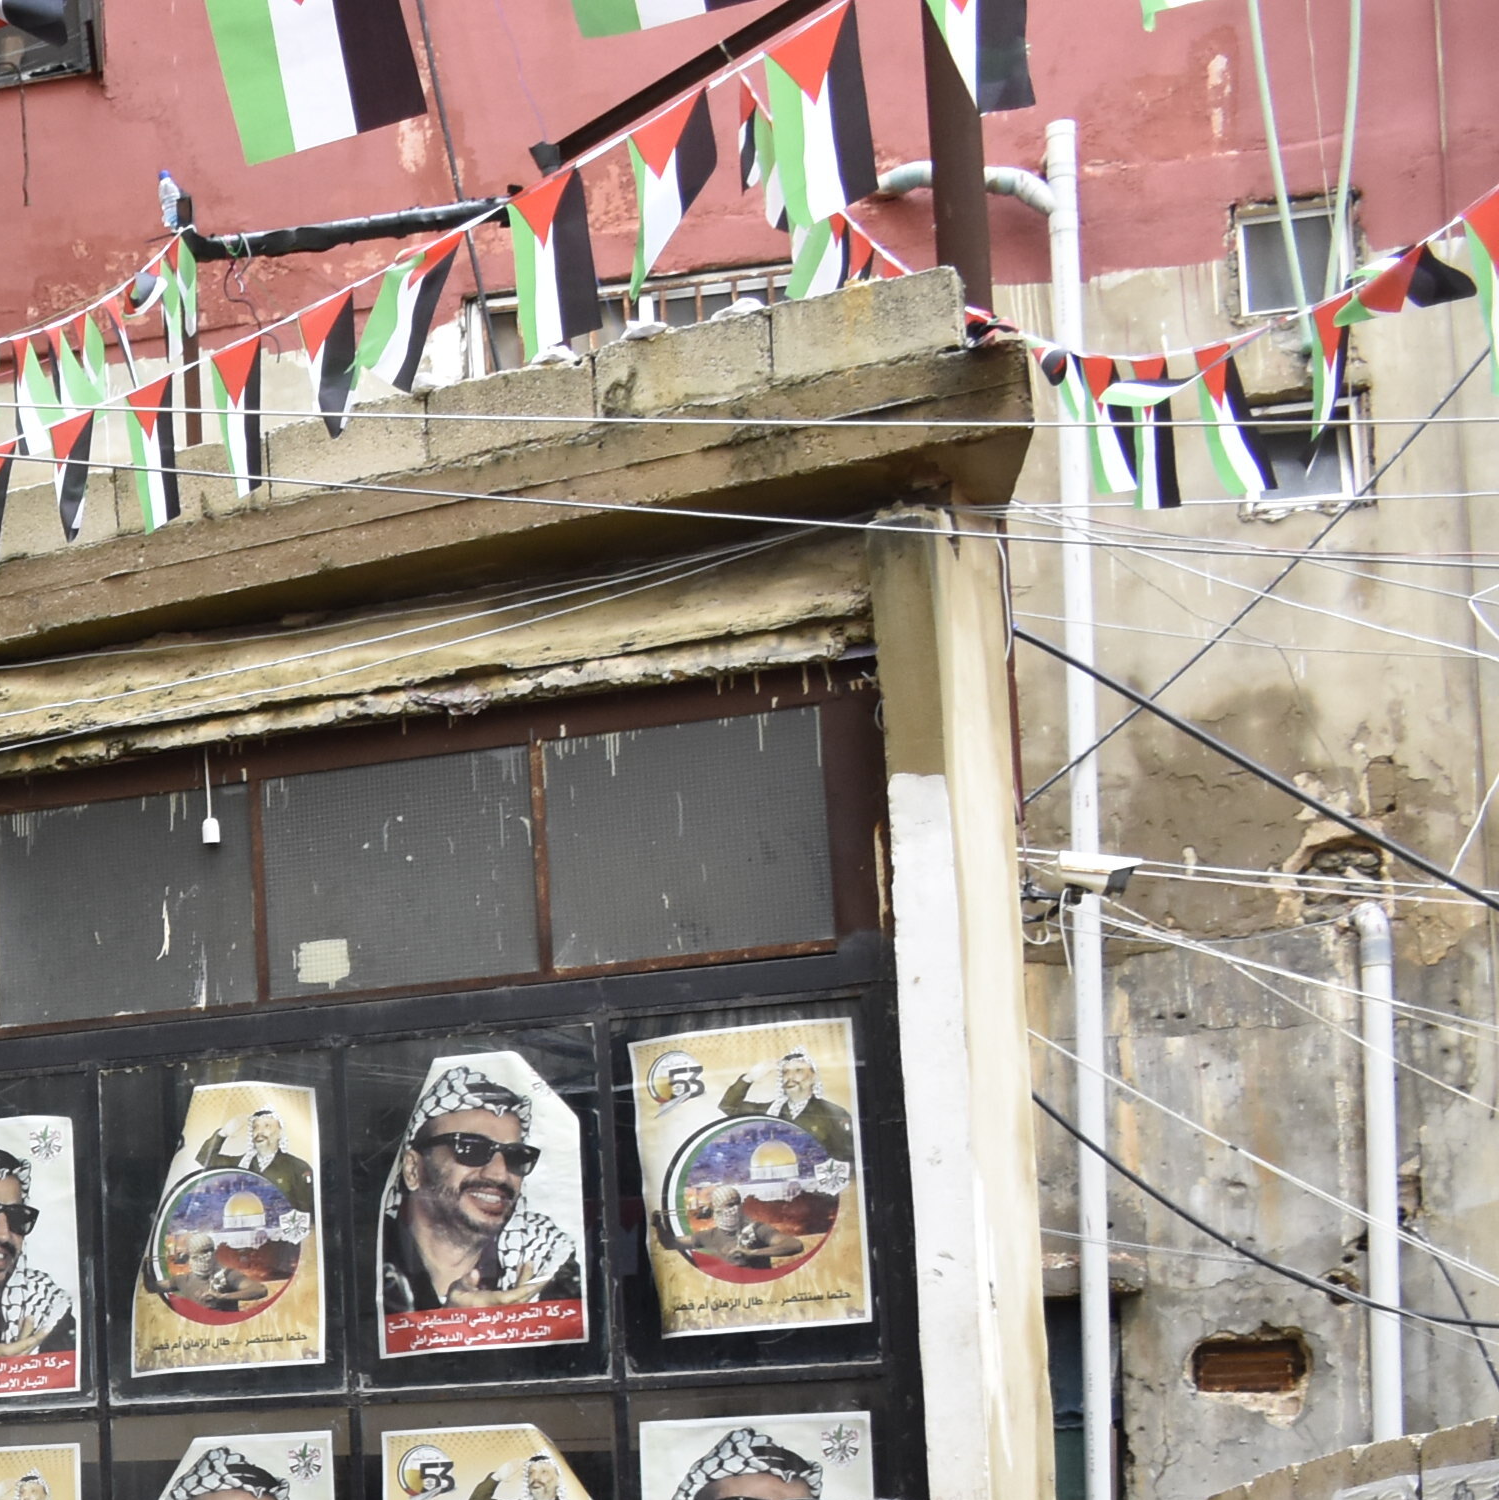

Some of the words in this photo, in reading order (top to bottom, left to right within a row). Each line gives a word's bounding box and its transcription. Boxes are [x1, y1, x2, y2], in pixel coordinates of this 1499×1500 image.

[668, 1066, 705, 1099] 53
[469, 1311, 503, 1327] الوطني
[505, 1308, 543, 1322] التحرير
[545, 1305, 577, 1318] حركة
[388, 1318, 409, 1333] فتح
[417, 1314, 467, 1329] الفلسطيني
[464, 1328, 519, 1345] الإصلاحي
[522, 1325, 551, 1339] التيار
[410, 1332, 463, 1349] الديمقراطي
[8, 1360, 41, 1373] التحرير
[44, 1357, 71, 1369] حركة
[23, 1375, 48, 1389] التيار
[420, 1462, 455, 1493] 53
